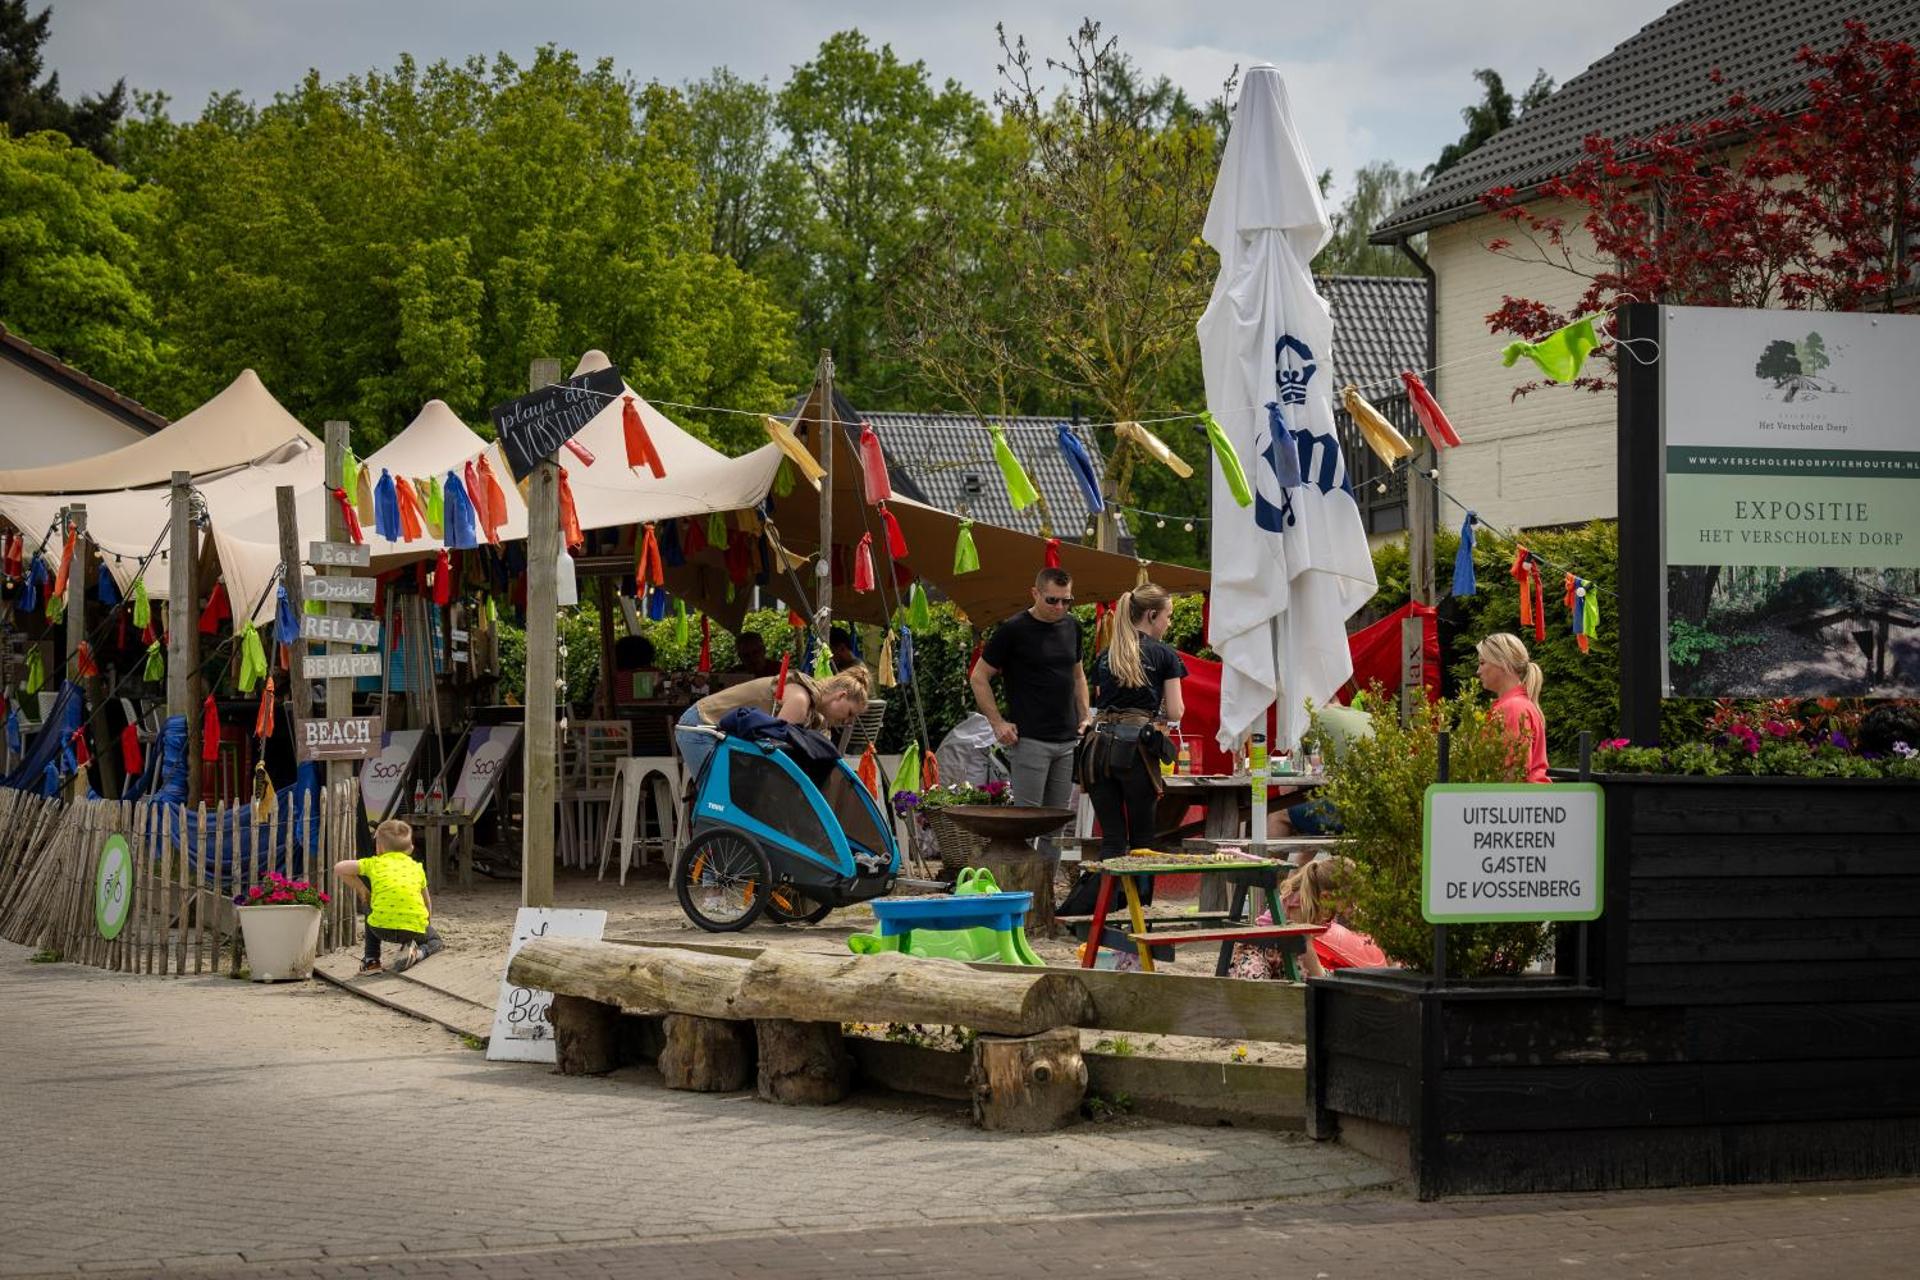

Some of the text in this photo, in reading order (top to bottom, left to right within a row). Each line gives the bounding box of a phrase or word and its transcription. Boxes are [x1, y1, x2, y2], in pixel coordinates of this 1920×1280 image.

[500, 377, 591, 438] playa del
[1759, 421, 1848, 433] Het Verscholen Dorp
[1688, 456, 1920, 469] WWW.VERSCHOLENDORPVIERHOUTEN.NL
[1735, 500, 1869, 522] EXPOSITIE
[1699, 529, 1904, 546] HET VERSCHOLEN DORP
[320, 544, 360, 564] Eat
[310, 579, 370, 598] Drink
[305, 617, 377, 642] RELAX
[305, 721, 371, 746] BEACH
[1463, 806, 1567, 824] UITSLUITEND
[1473, 831, 1555, 849] PARKEREN
[1481, 856, 1546, 874] GASTEN
[1446, 880, 1581, 899] DE VOSSENBERG
